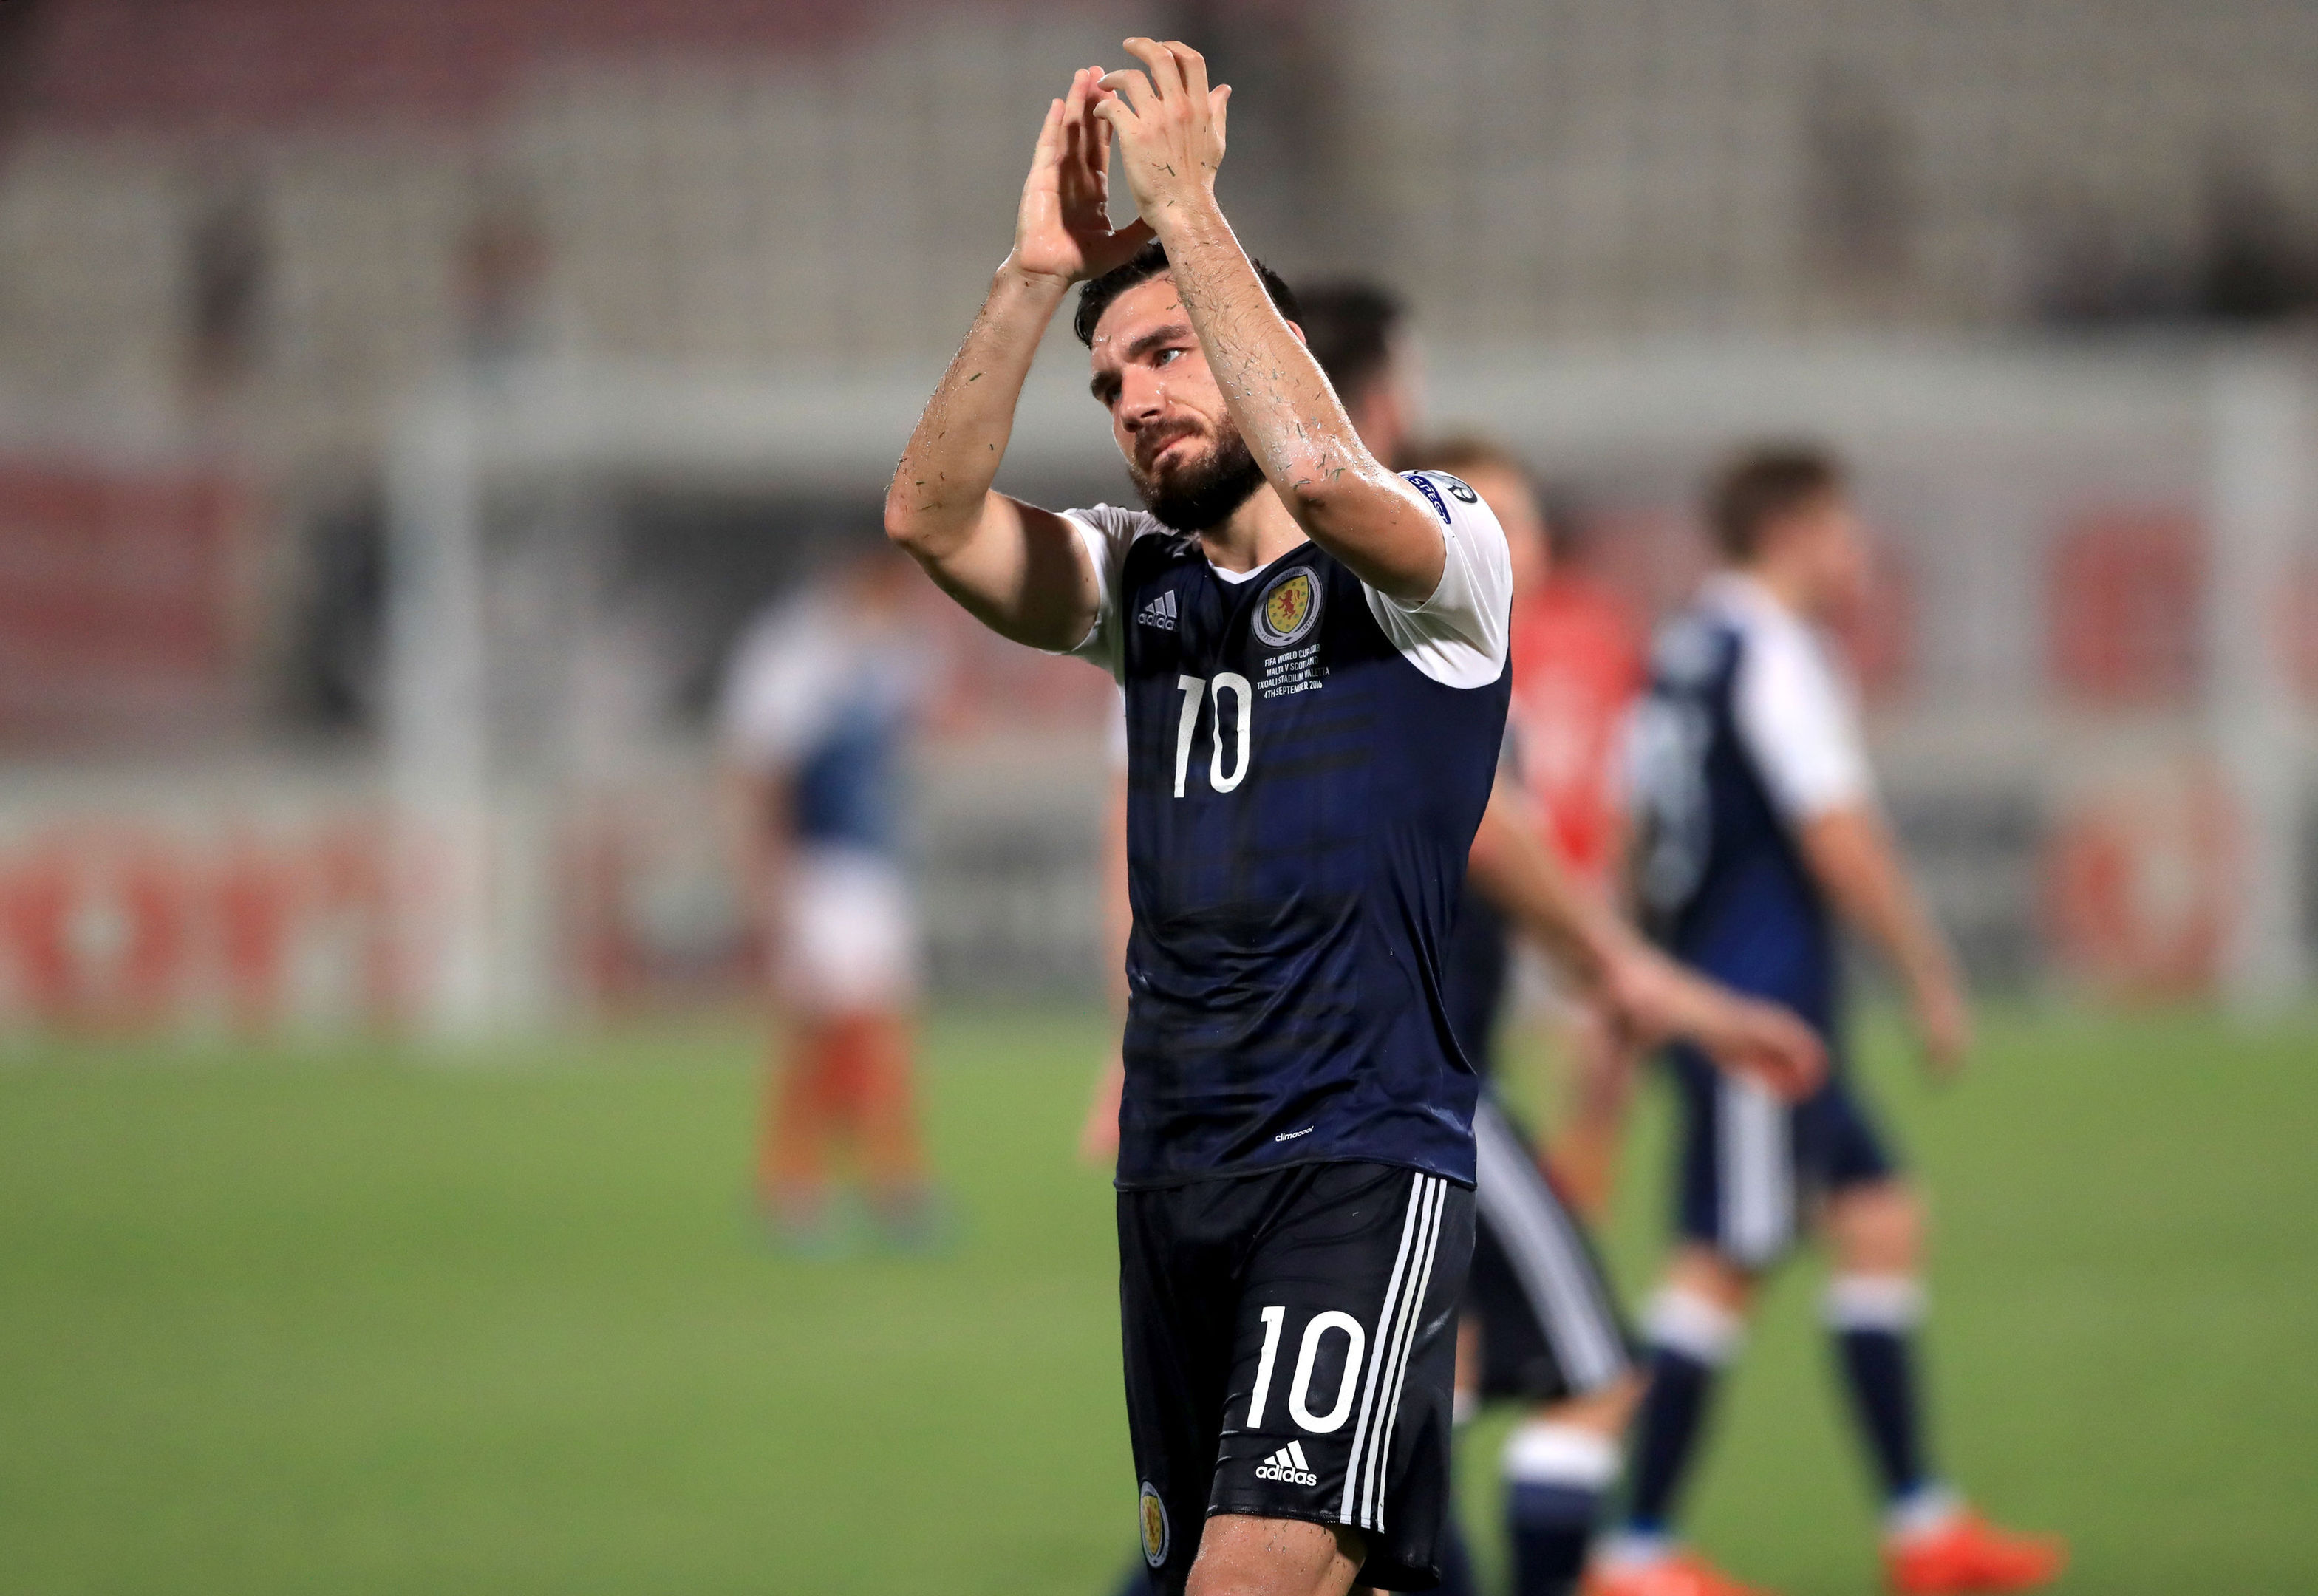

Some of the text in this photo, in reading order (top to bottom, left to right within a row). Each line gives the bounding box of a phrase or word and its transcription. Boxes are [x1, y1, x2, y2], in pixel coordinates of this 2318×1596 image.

[1264, 657, 1277, 667] FIFA
[1277, 650, 1298, 664] WORLD
[1298, 647, 1309, 658] CUP
[1266, 655, 1319, 677] MALTA V SCOTLAND
[1304, 666, 1330, 678] VALETTA
[1264, 680, 1323, 699] 4TH SEPTEMBER 2016
[1174, 672, 1252, 798] 10
[1275, 1125, 1315, 1142] climacool
[1246, 1306, 1366, 1433] 10
[1255, 1464, 1317, 1487] adidas
